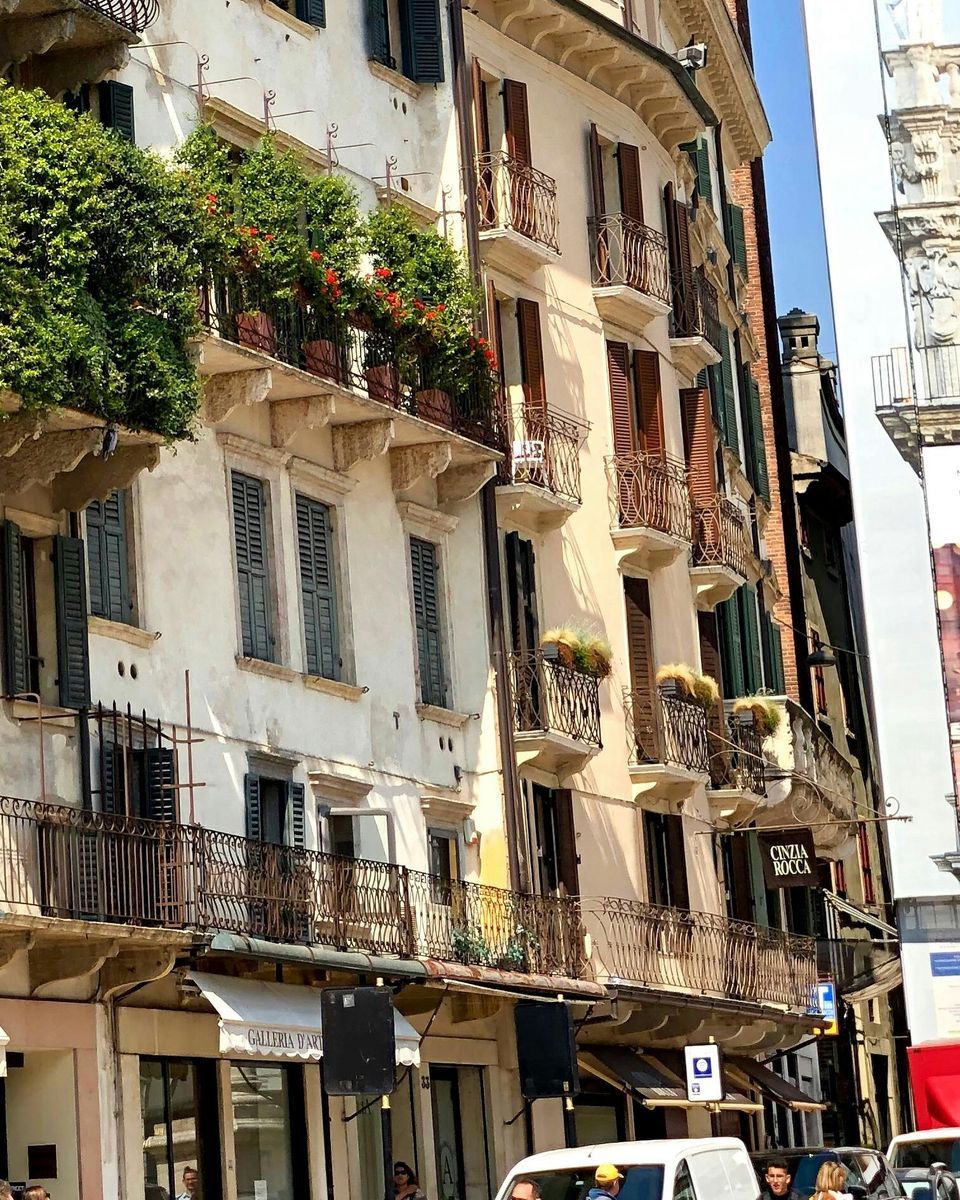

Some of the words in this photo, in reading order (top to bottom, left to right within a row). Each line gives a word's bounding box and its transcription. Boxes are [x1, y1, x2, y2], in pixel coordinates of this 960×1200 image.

[770, 844, 809, 861] CINZIA
[773, 859, 812, 876] ROCCA
[248, 1028, 295, 1049] GALLERIA
[421, 1075, 430, 1089] 33
